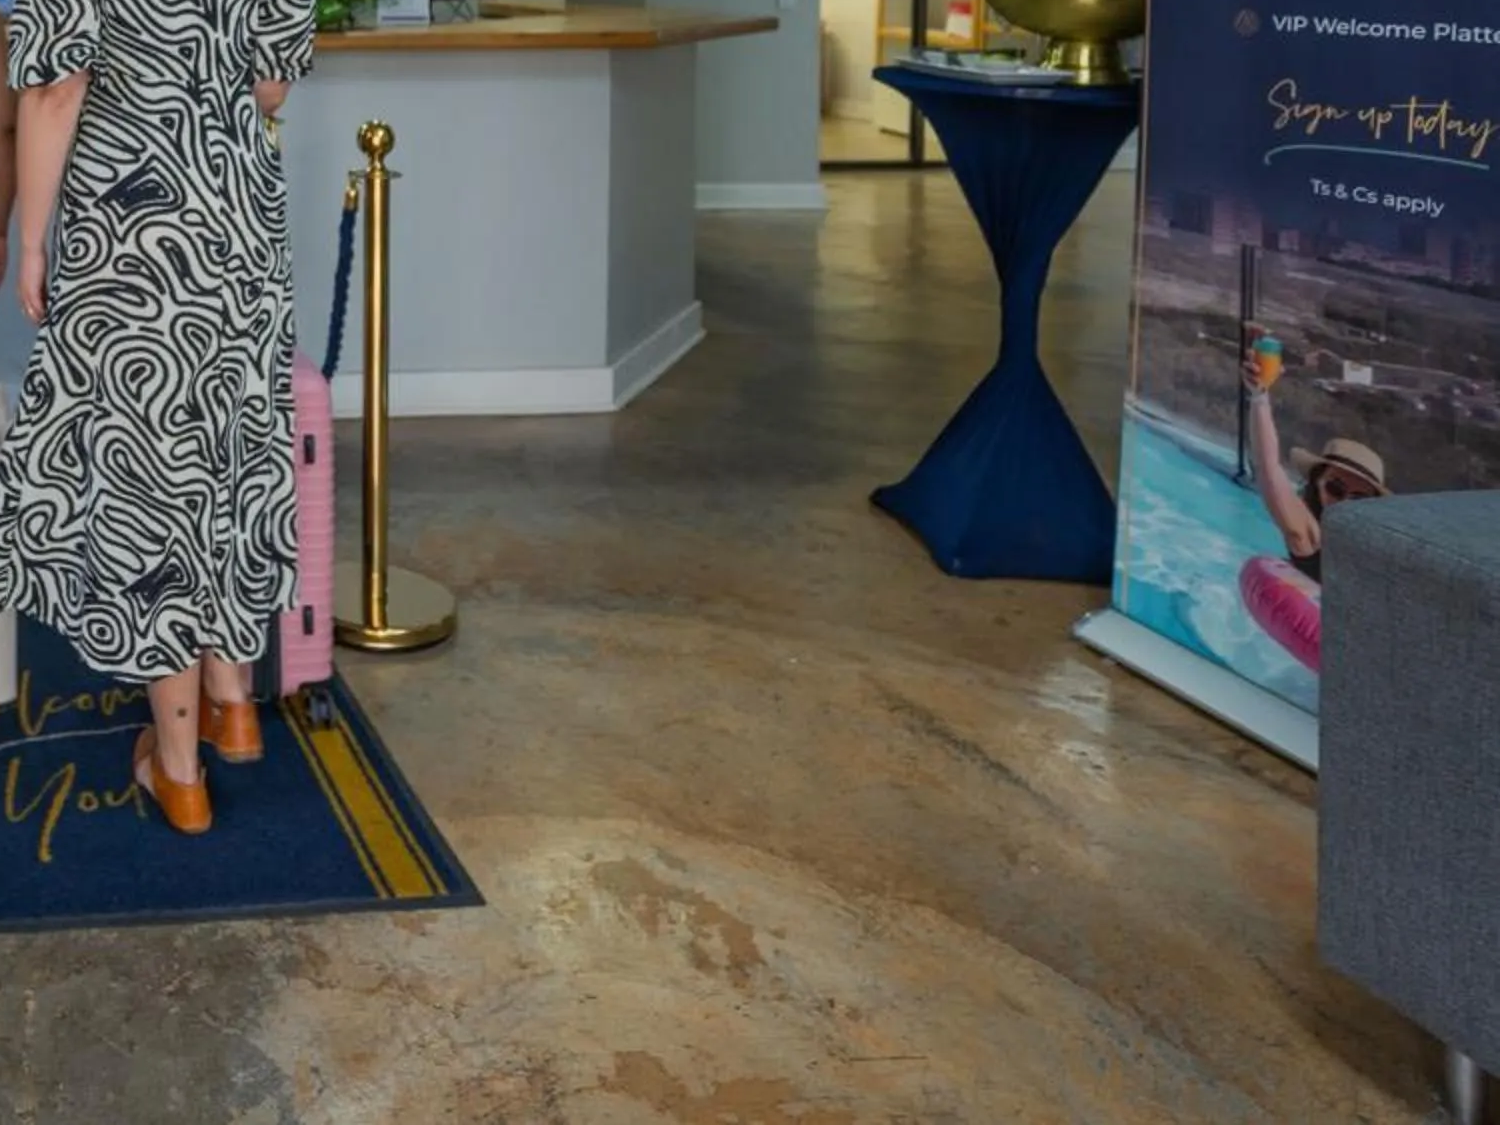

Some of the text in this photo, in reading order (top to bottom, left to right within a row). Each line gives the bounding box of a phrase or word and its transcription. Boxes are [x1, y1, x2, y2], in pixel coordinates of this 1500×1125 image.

[1273, 14, 1308, 32] VIP
[1313, 18, 1426, 40] Welcome
[1267, 78, 1498, 159] Sign up today
[1310, 179, 1444, 218] Ts & Cs apply
